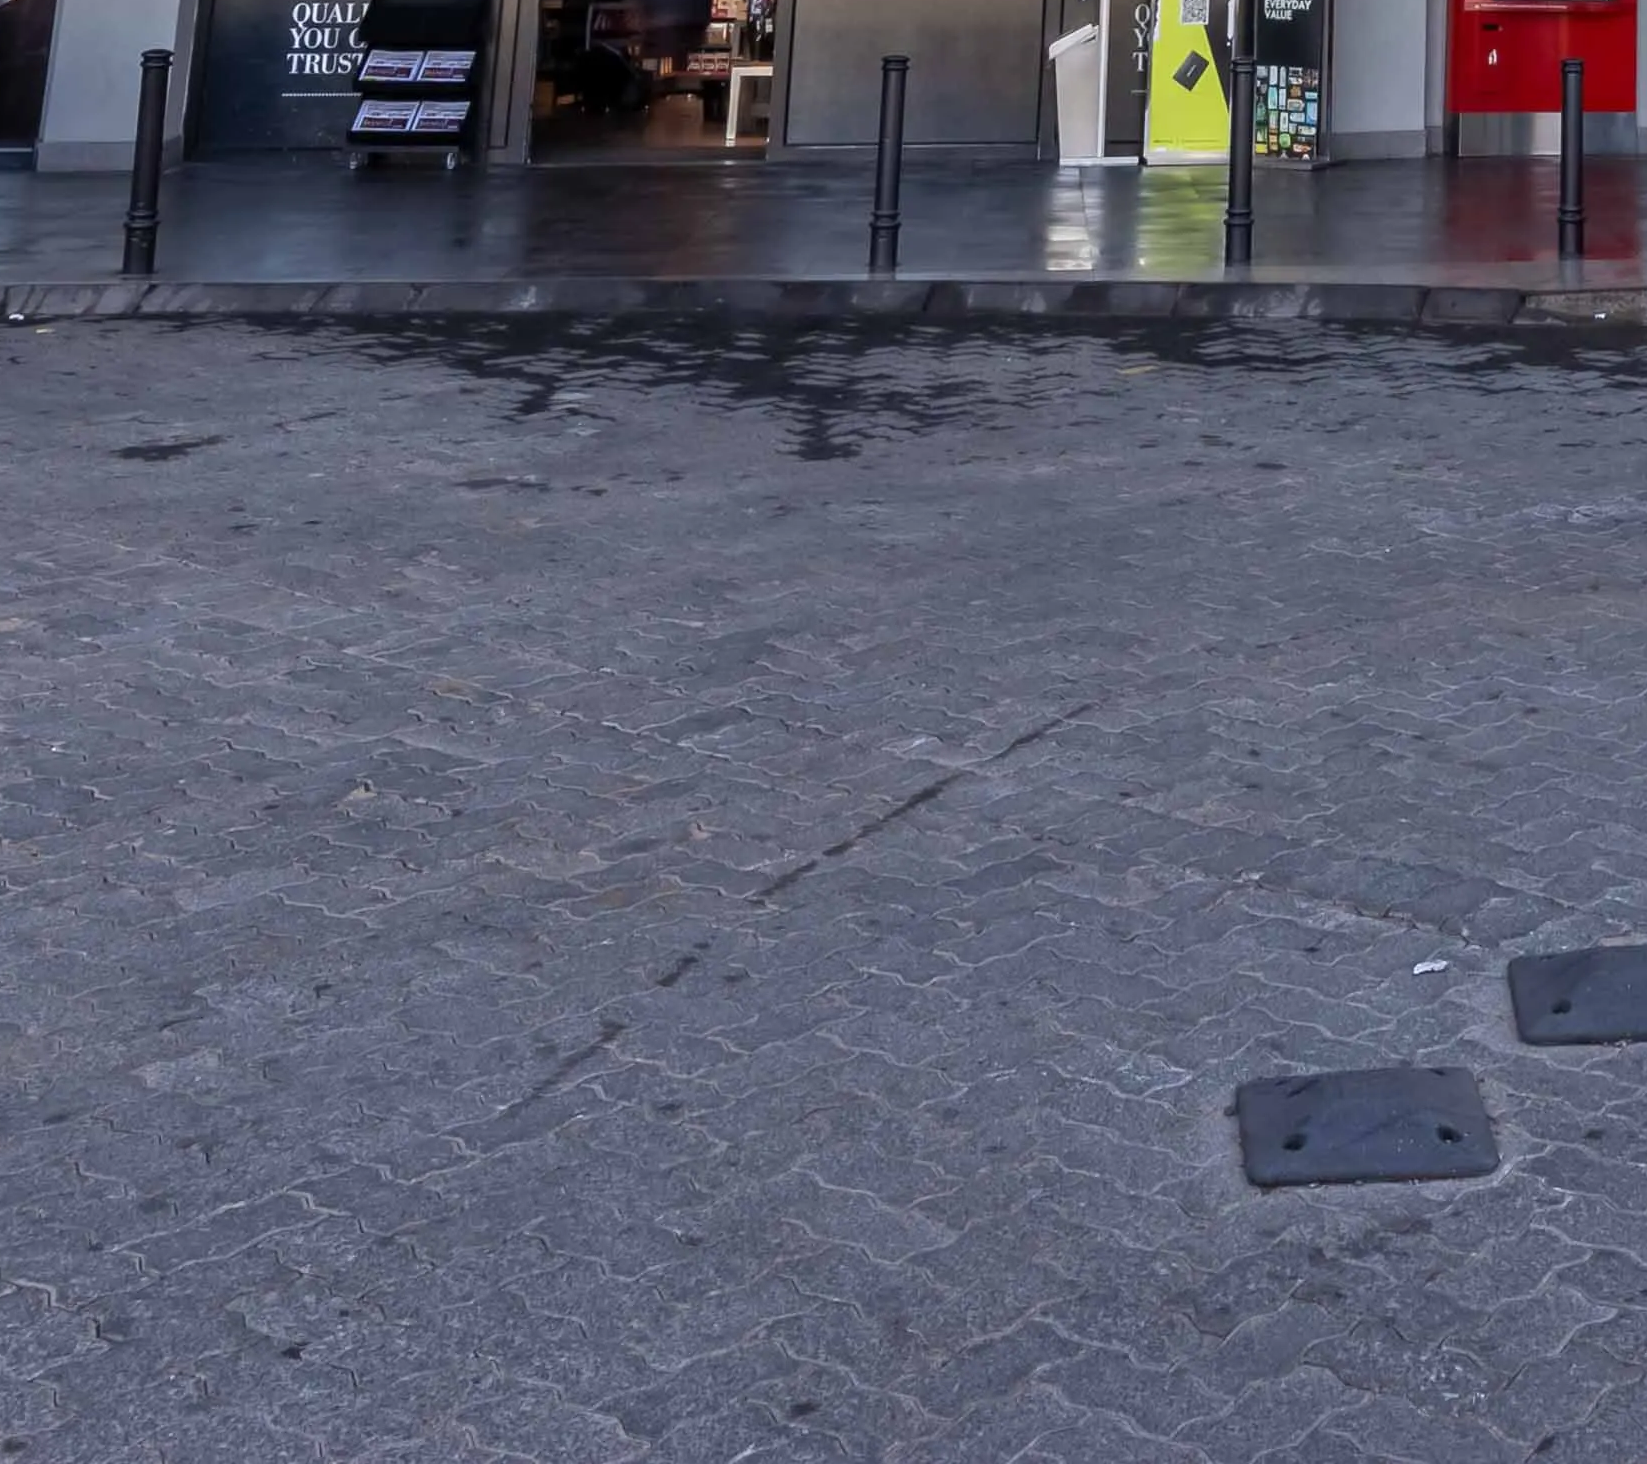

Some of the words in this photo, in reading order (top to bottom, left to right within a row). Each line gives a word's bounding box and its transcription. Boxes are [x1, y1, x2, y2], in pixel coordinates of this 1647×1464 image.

[1264, 0, 1312, 10] EVERYDAY
[1264, 10, 1293, 20] VALUE
[290, 28, 340, 50] YOU
